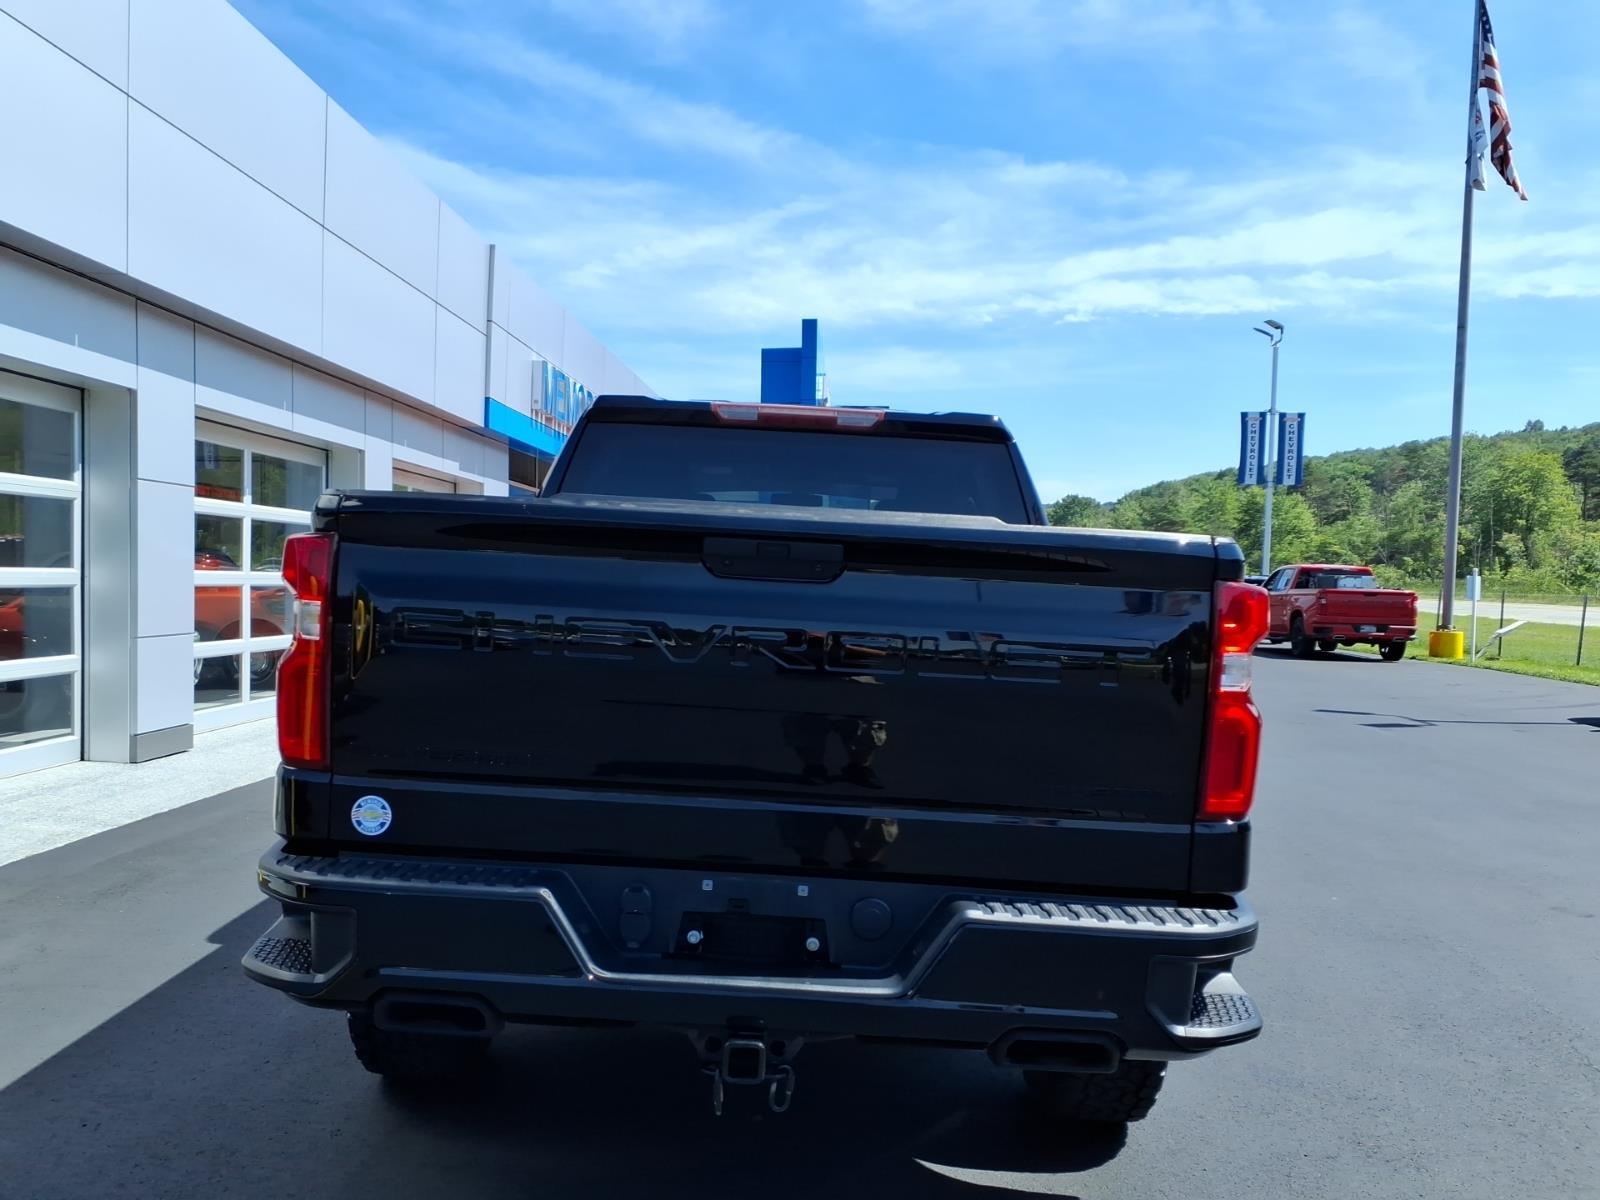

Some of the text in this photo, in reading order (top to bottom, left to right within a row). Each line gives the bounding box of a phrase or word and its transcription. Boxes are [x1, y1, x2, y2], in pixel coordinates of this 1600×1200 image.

[1248, 423, 1257, 479] CHEVROLET
[1287, 424, 1296, 480] CHEVROLET
[390, 606, 1152, 688] CHEVROLET
